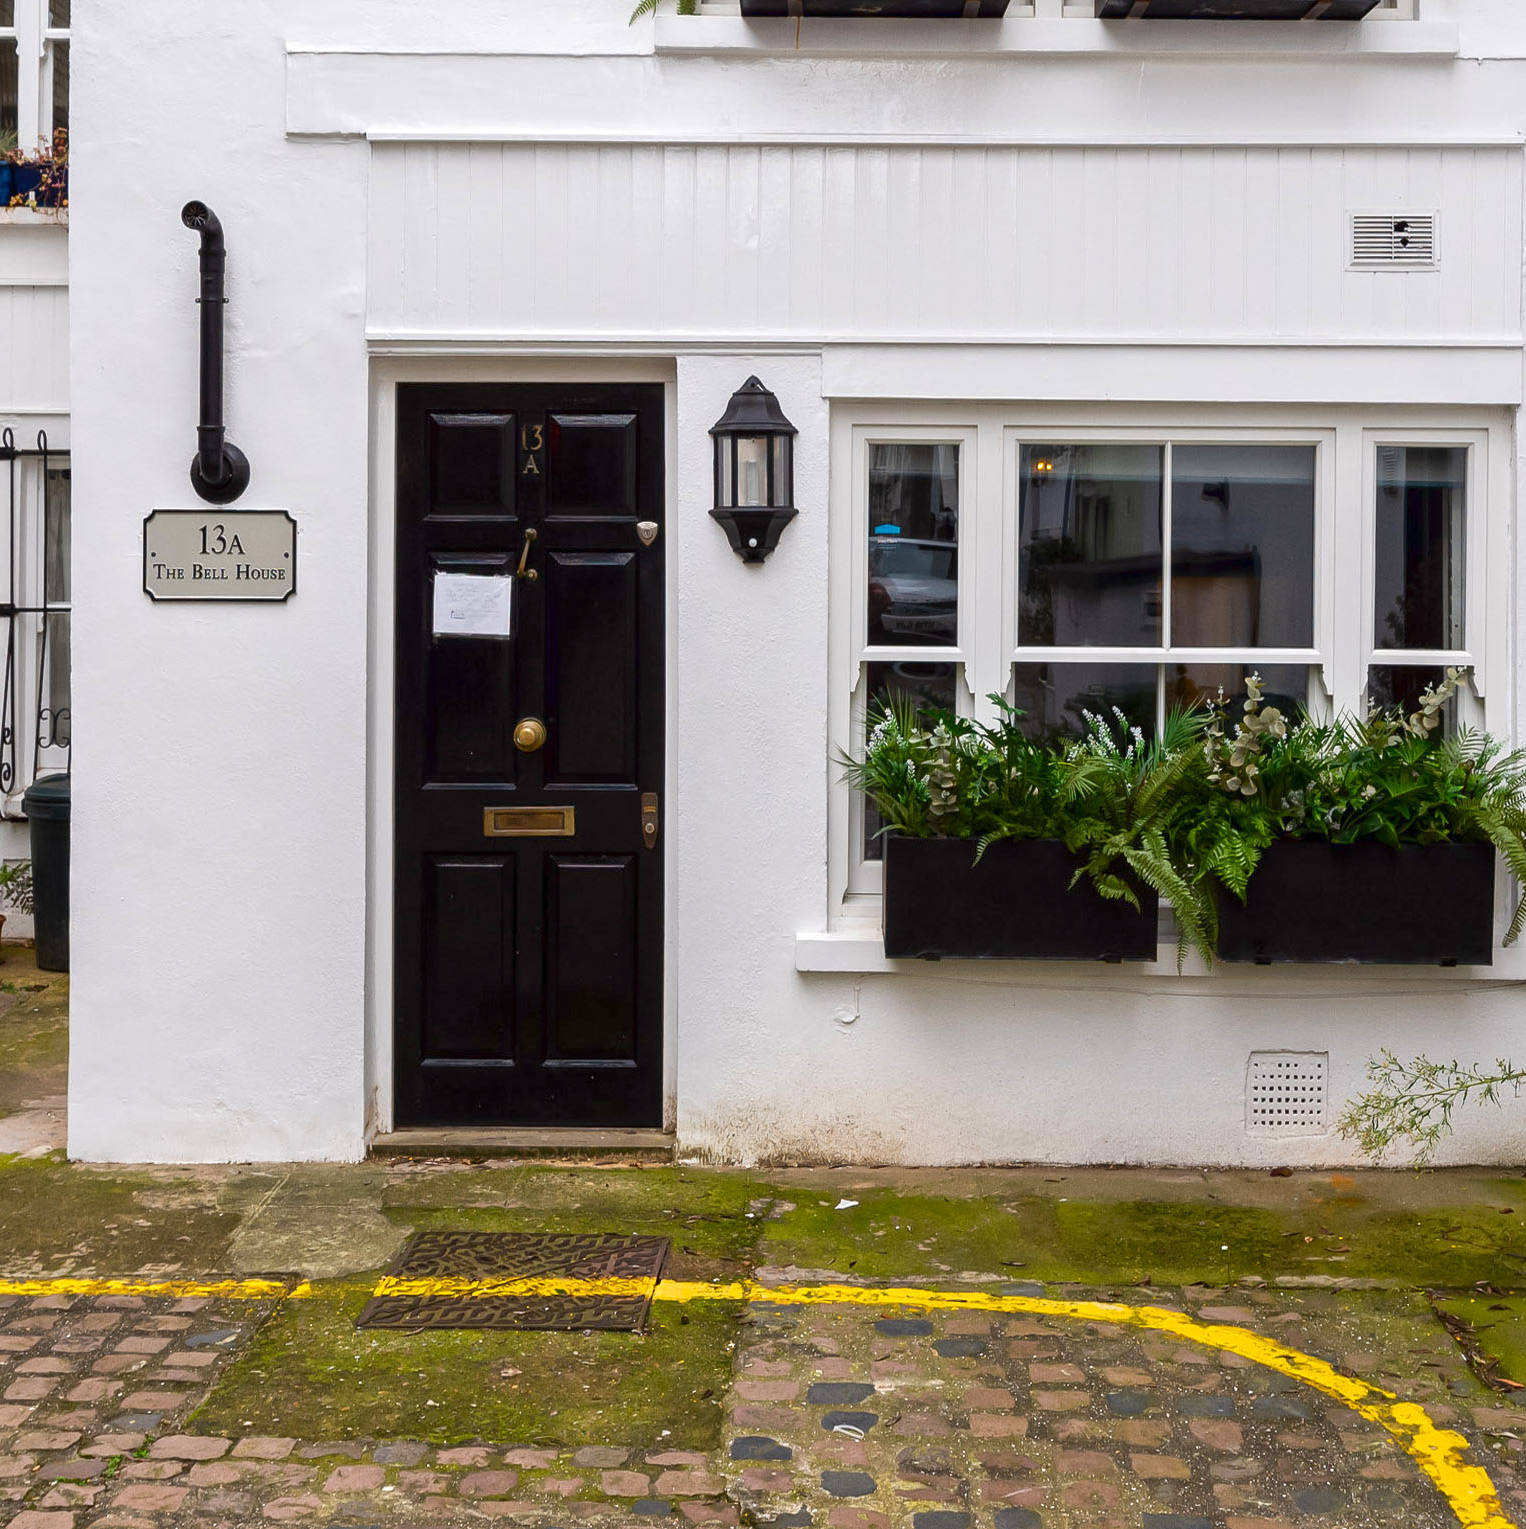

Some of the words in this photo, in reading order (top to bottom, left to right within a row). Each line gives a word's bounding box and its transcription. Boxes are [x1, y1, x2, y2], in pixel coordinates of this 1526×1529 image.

[522, 424, 543, 451] 13
[523, 454, 540, 474] A
[198, 524, 246, 555] 13A
[153, 563, 185, 580] THE
[192, 563, 229, 580] BELL
[235, 563, 286, 580] HOUSE
